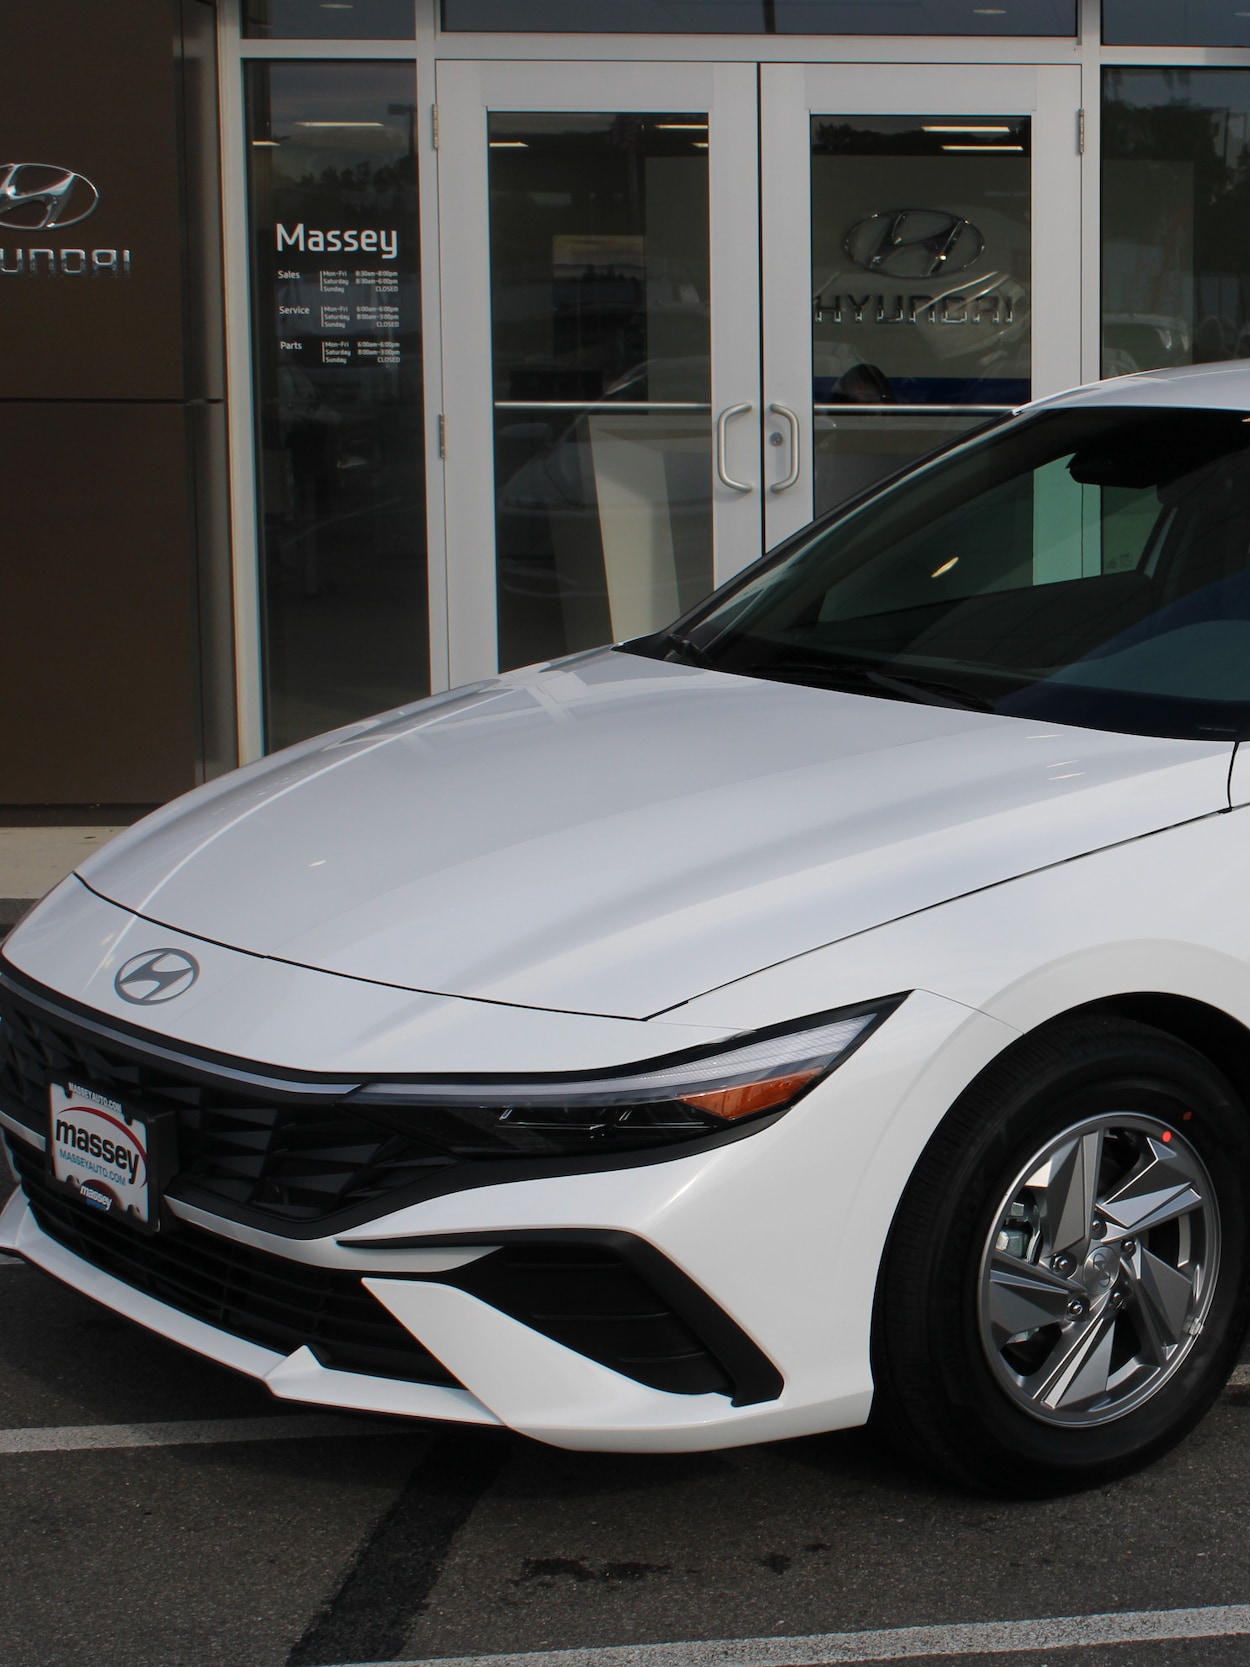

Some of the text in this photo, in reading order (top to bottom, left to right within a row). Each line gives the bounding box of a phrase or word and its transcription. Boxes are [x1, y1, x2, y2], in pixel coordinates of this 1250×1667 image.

[276, 223, 398, 259] Massey
[278, 270, 301, 279] Sales
[279, 305, 310, 315] Service
[324, 313, 350, 321] Saturday
[815, 295, 1014, 323] HYUNDAI
[324, 321, 346, 329] Sunday
[280, 341, 303, 350] Parts
[68, 1082, 122, 1112] MASSEYAUTO.COM
[56, 1119, 140, 1184] massey
[59, 1148, 126, 1186] MASSEYAUTO.COM
[80, 1185, 113, 1211] massey
